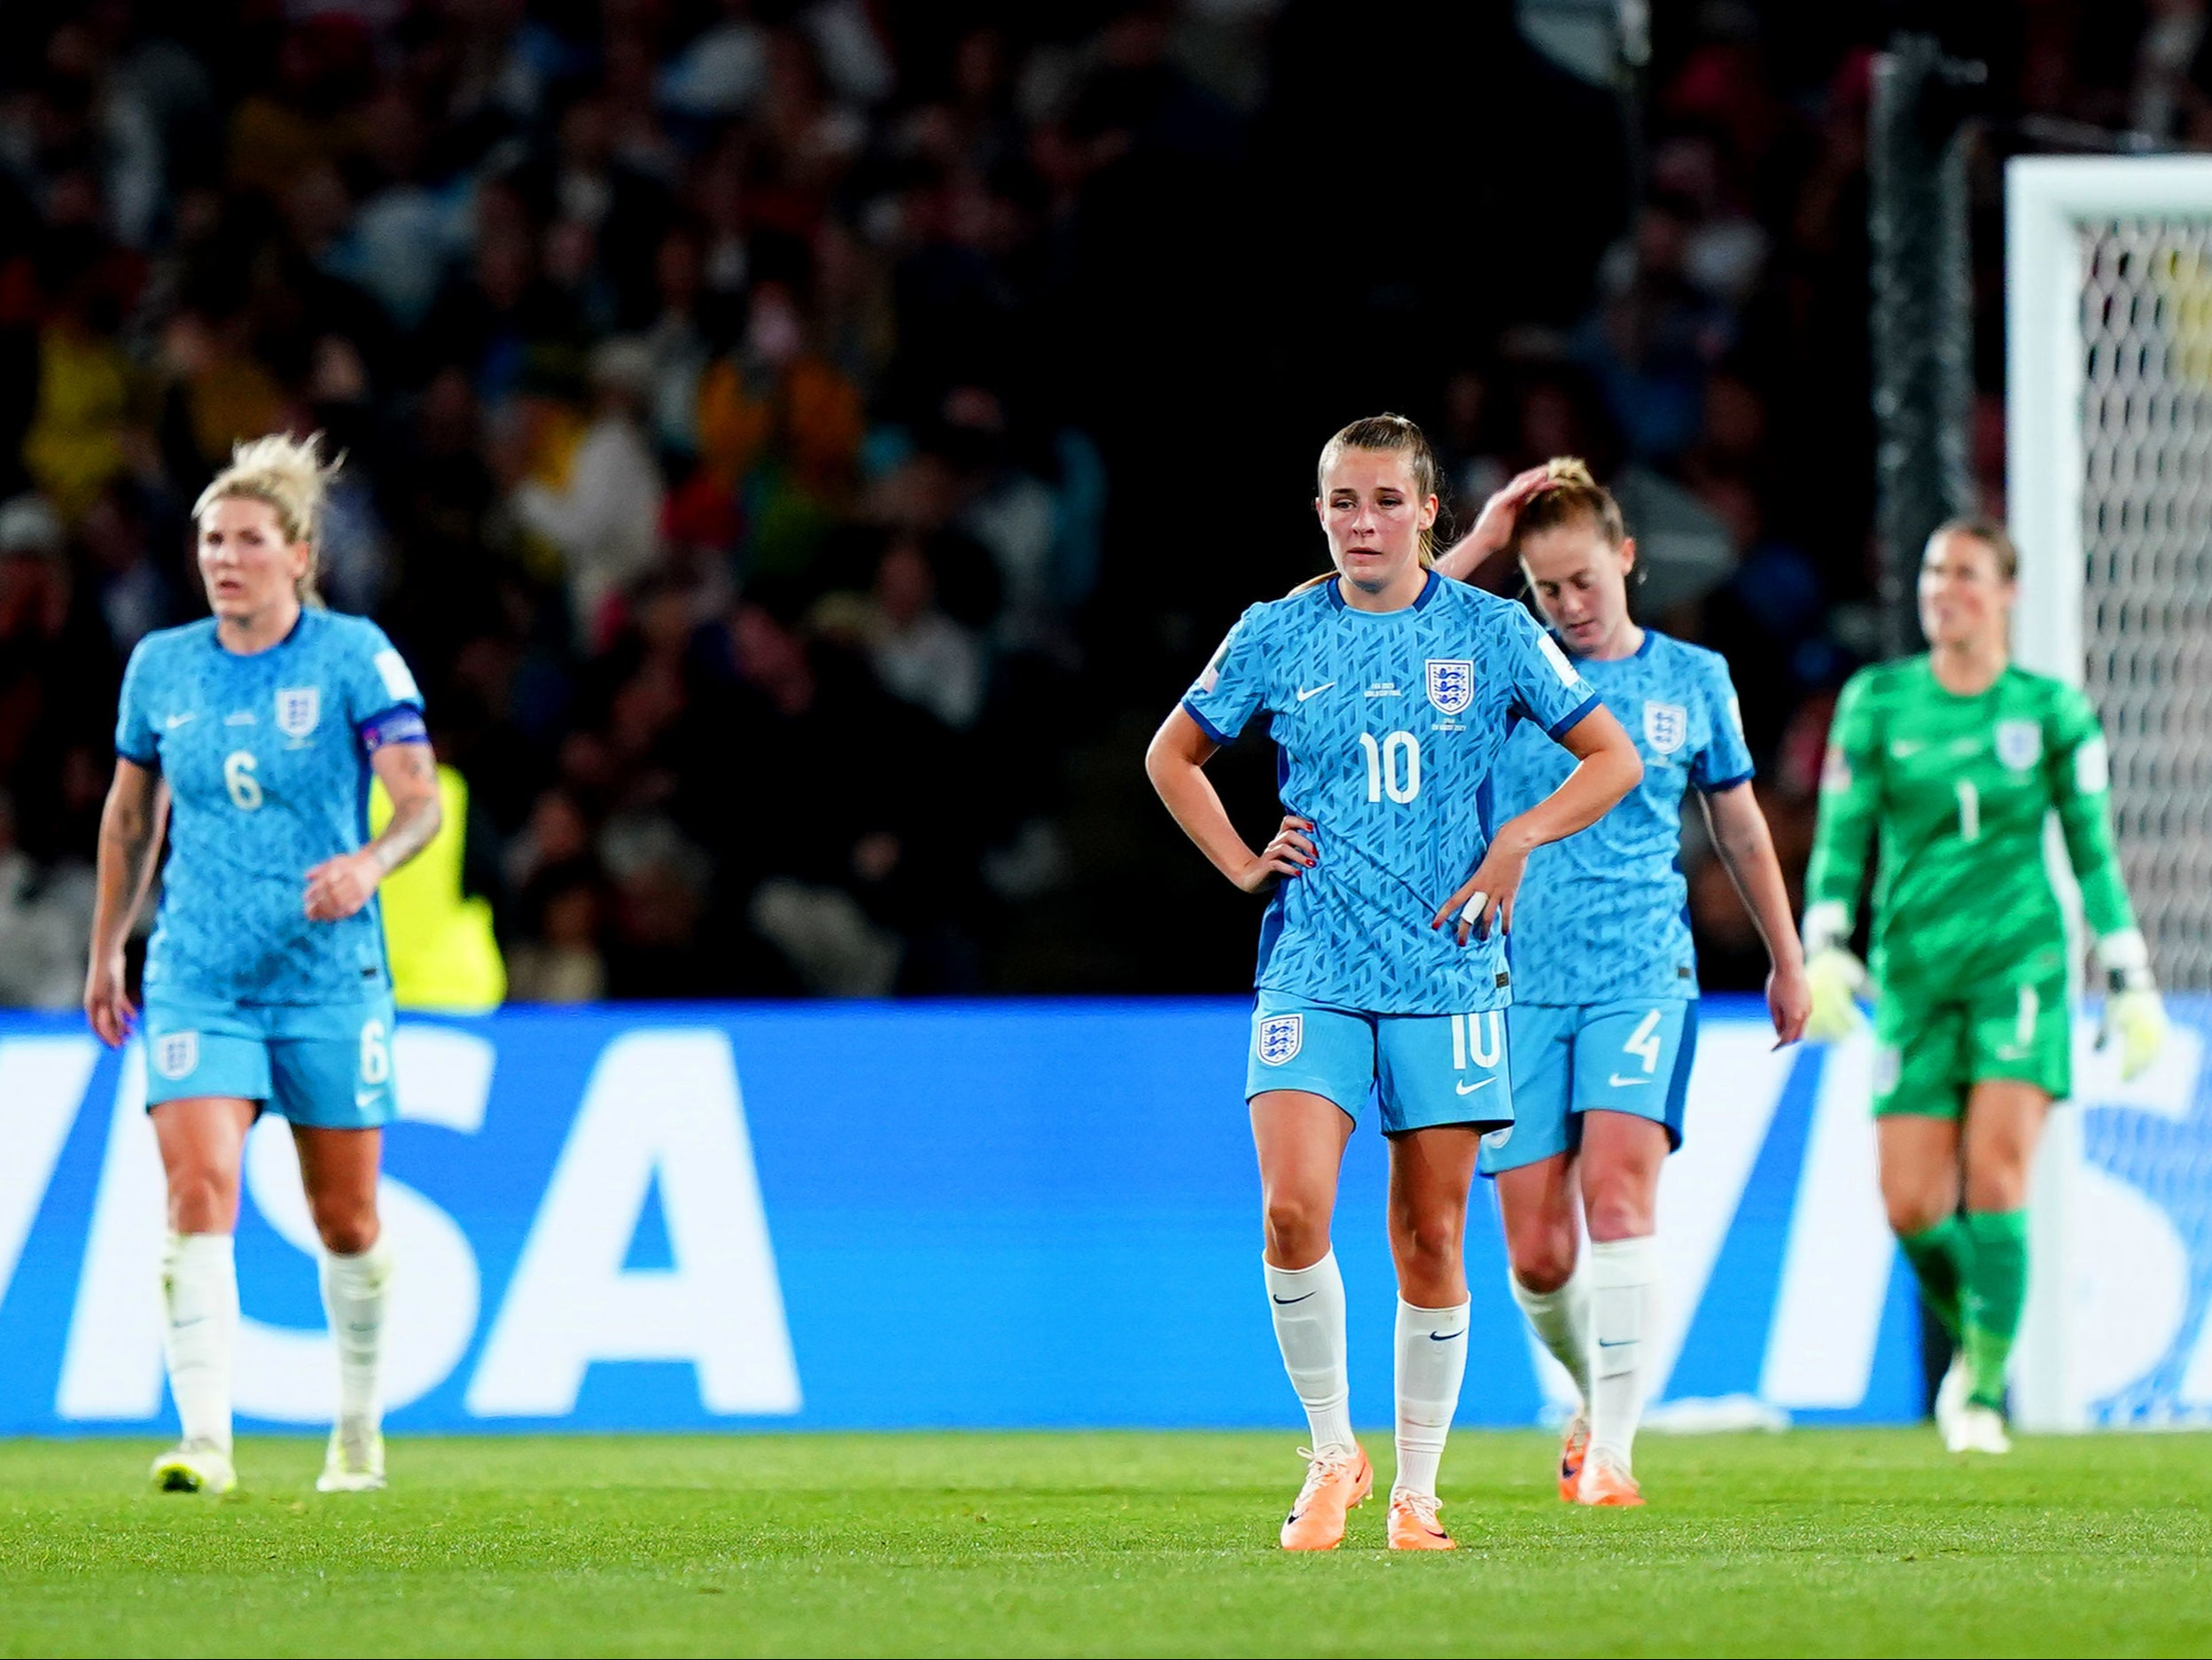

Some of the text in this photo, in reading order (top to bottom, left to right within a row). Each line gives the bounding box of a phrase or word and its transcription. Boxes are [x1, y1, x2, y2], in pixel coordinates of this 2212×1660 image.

[224, 751, 263, 811] 6
[1359, 730, 1421, 804] 10
[1955, 778, 1981, 842] 1
[360, 1018, 389, 1085] 6
[1451, 1009, 1501, 1070] 10
[1623, 1008, 1663, 1073] 4
